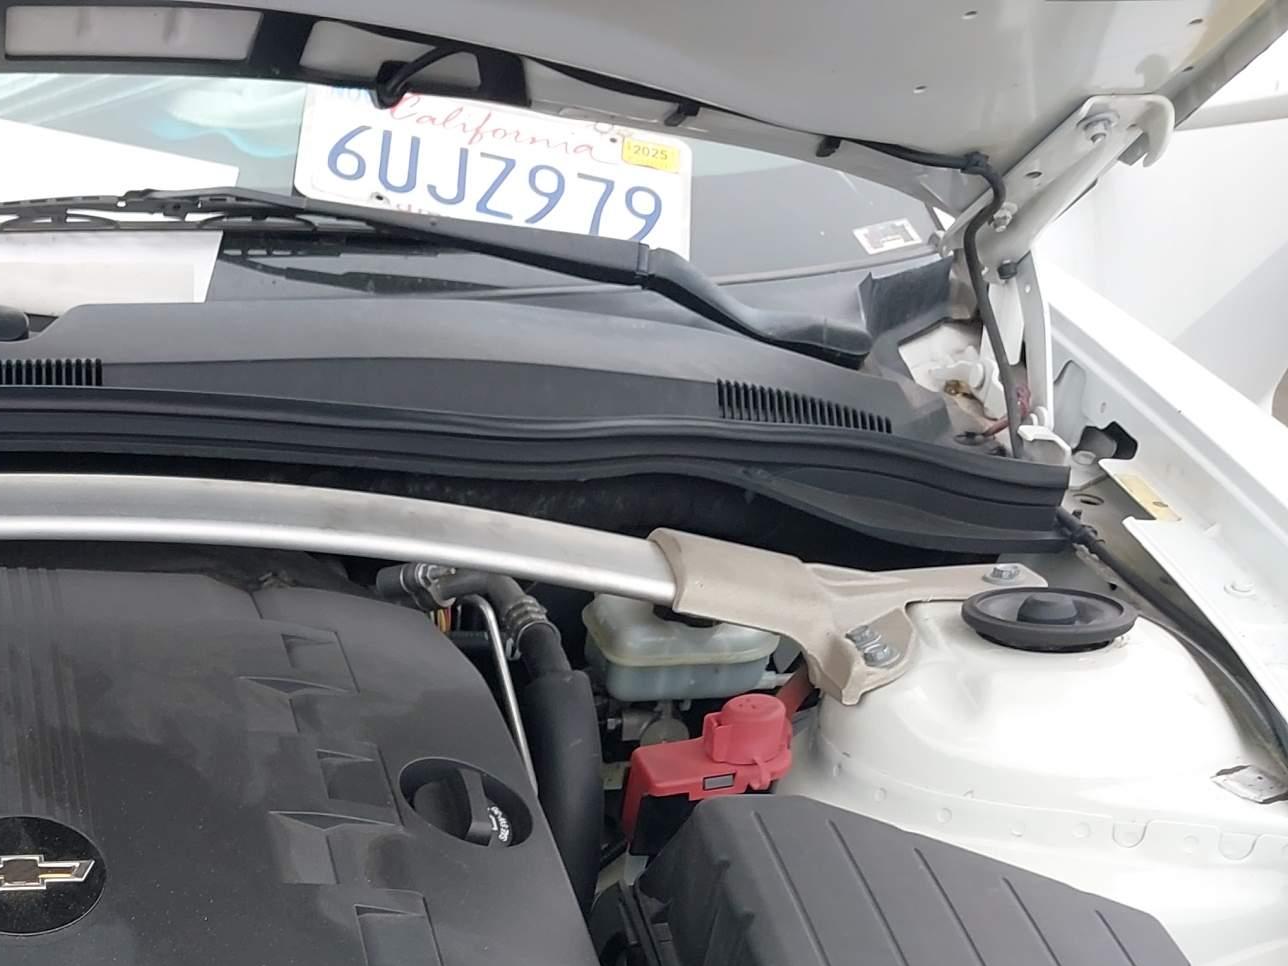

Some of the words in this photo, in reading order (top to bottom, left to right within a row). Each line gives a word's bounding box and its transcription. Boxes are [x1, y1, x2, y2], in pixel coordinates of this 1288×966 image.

[390, 93, 602, 160] California
[633, 144, 668, 161] 2025
[326, 125, 663, 243] 6UJZ979
